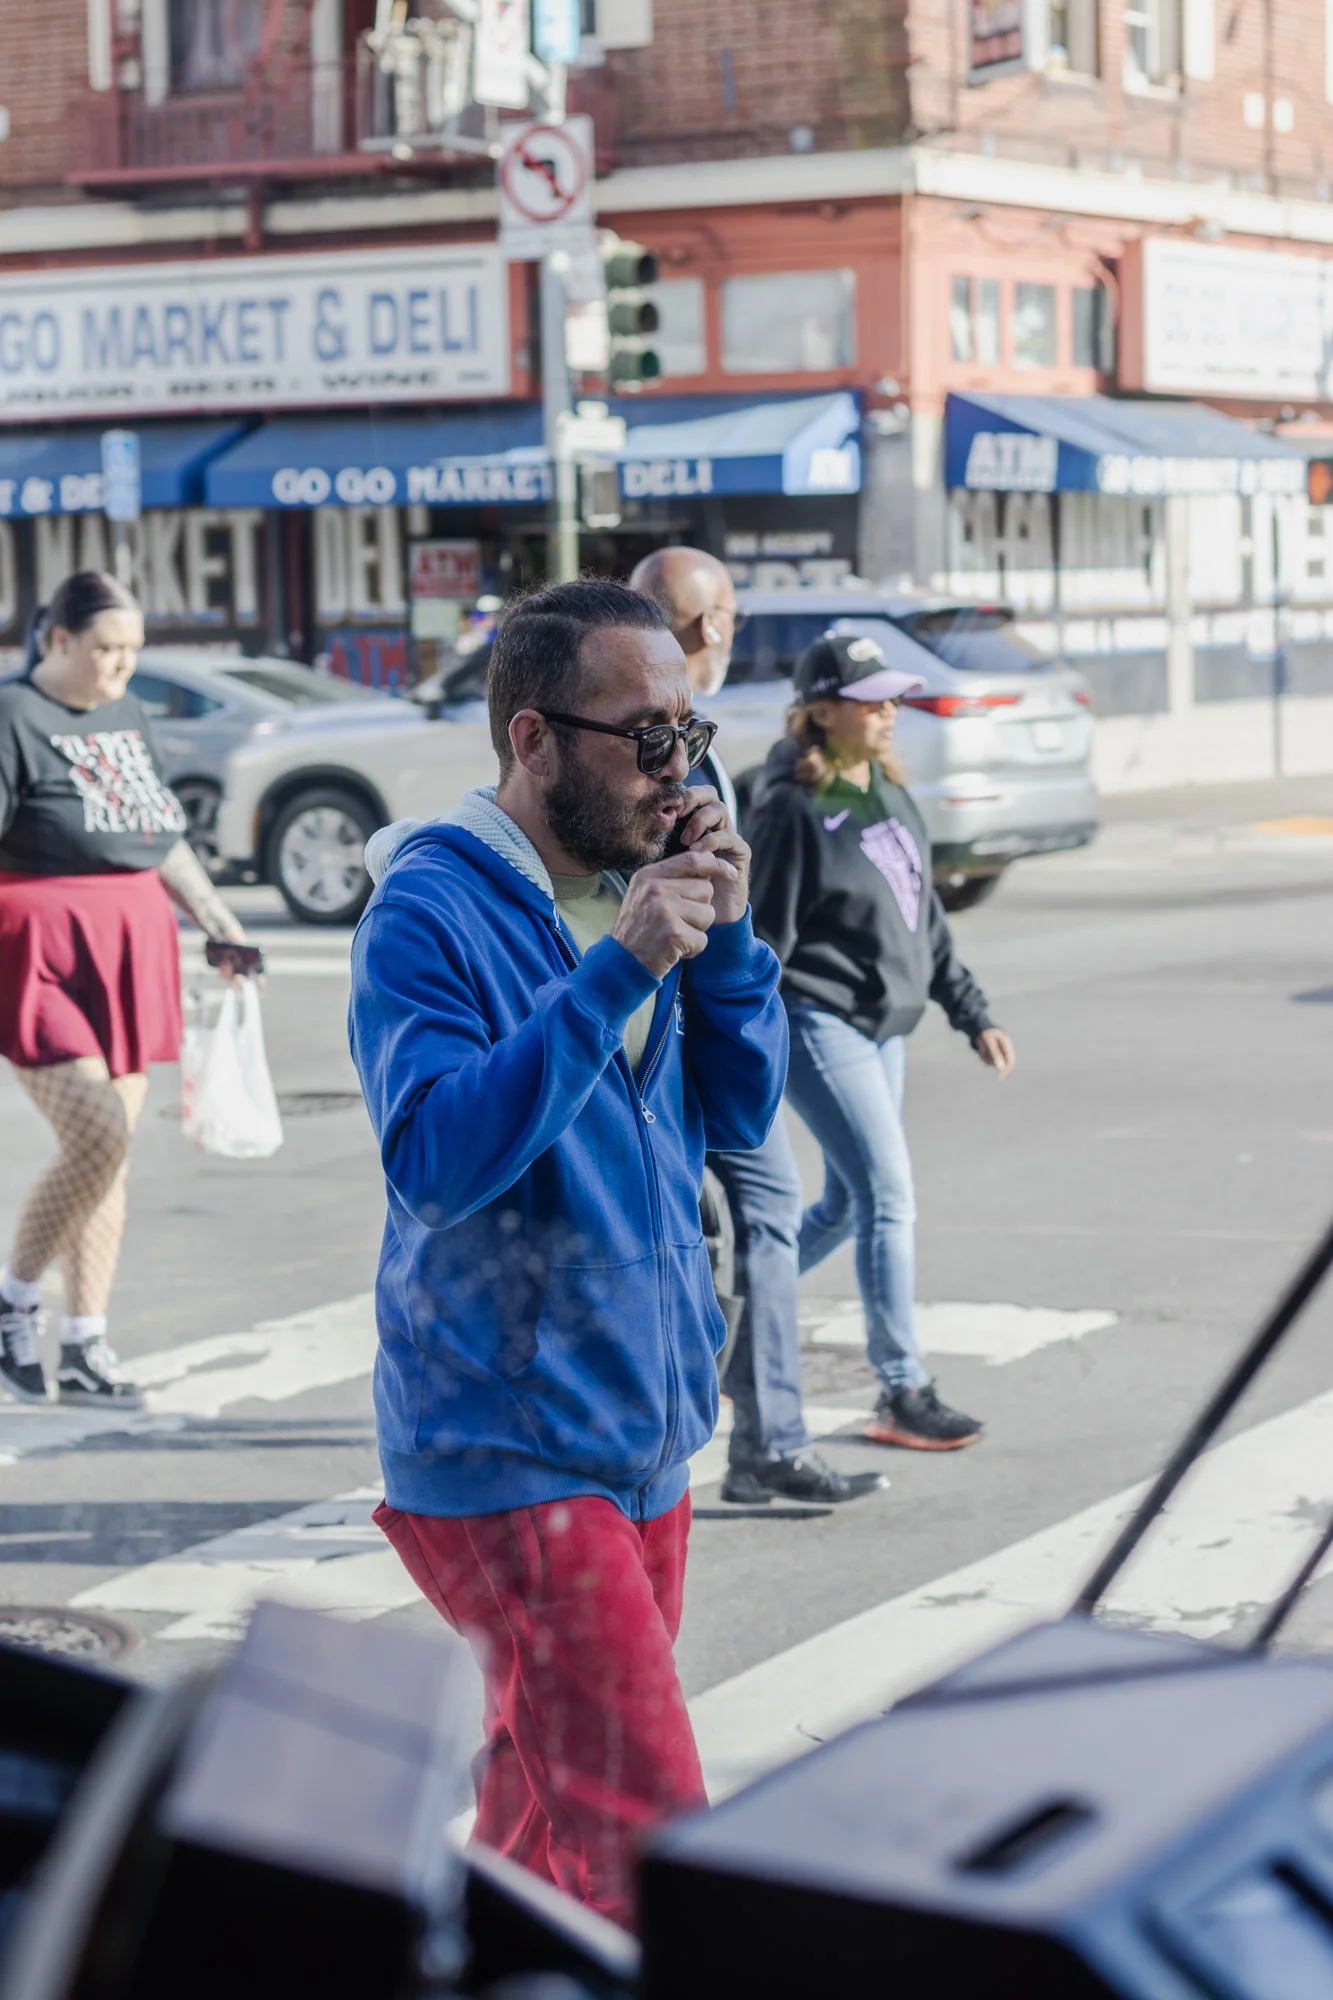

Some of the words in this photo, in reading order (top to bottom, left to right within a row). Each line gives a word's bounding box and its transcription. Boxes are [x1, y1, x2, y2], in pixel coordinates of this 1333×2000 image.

[0, 312, 60, 371] GO
[82, 297, 289, 369] MARKET
[314, 287, 346, 362] &
[369, 285, 478, 356] DELI
[967, 432, 1057, 476] ATM
[272, 467, 331, 504] GO
[335, 466, 397, 504] GO
[406, 464, 551, 502] MARKET
[622, 459, 712, 497] DELI
[327, 634, 408, 690] ATM
